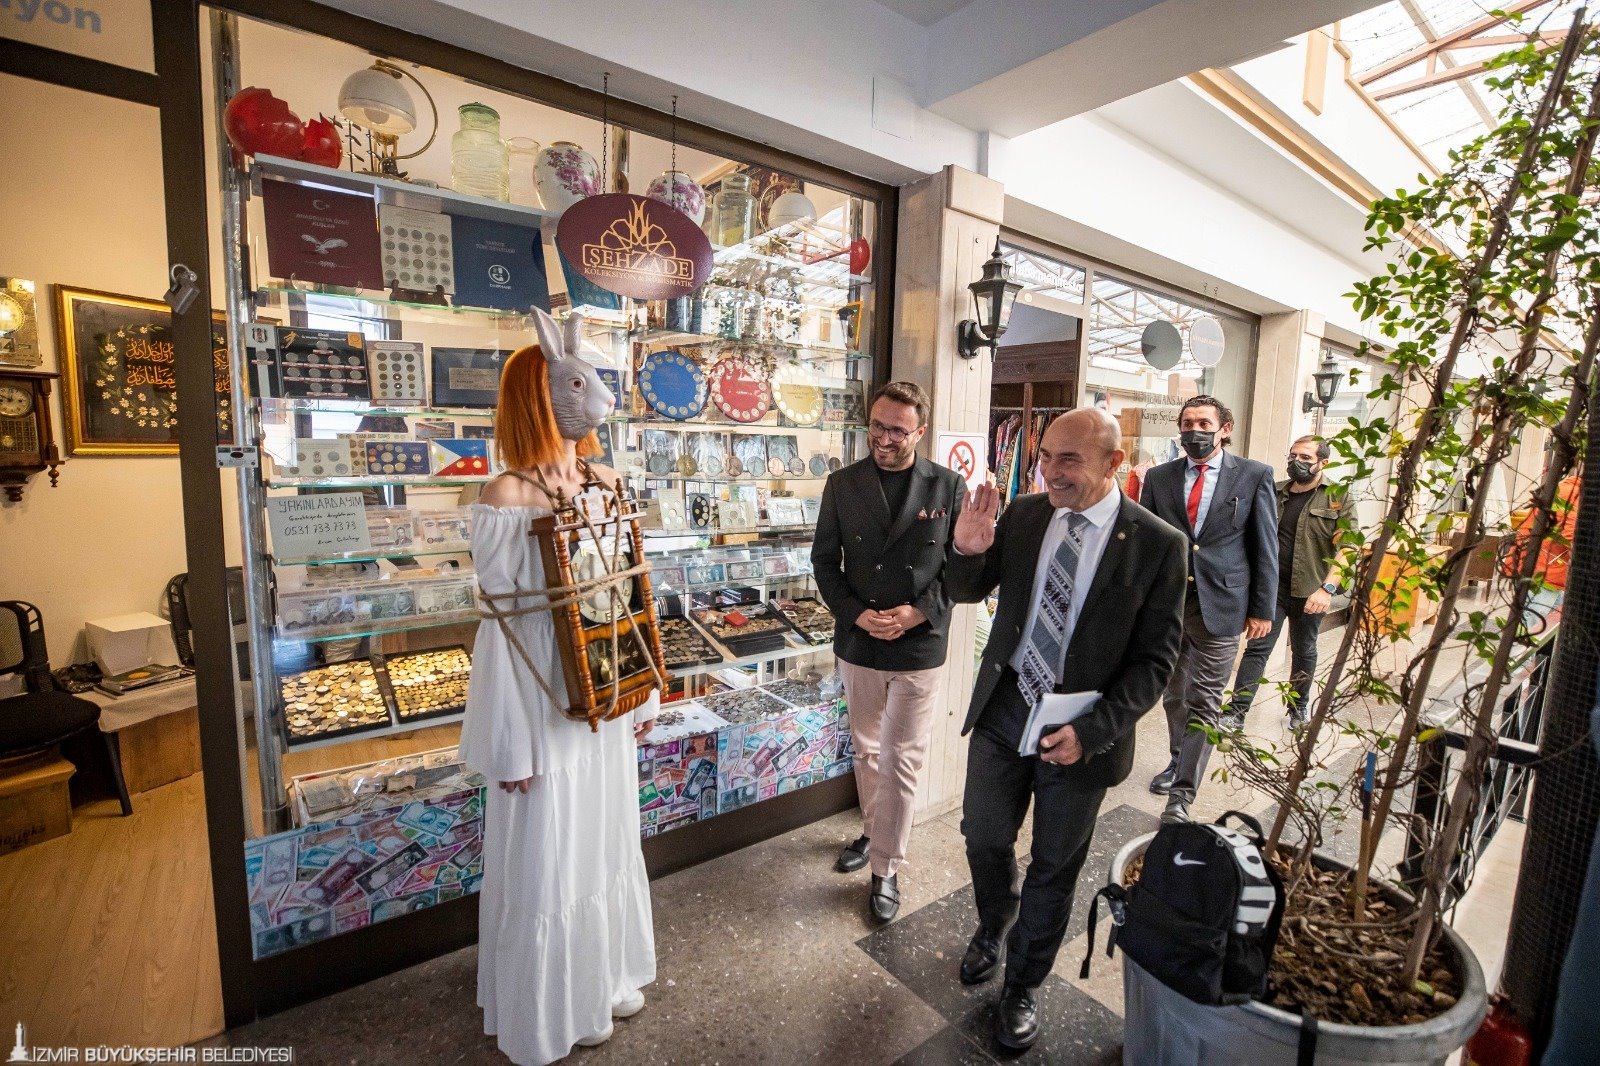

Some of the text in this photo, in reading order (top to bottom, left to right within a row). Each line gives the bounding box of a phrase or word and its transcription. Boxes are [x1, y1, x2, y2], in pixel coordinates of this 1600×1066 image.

[0, 0, 101, 33] yon
[589, 248, 690, 277] ŞEHZADE
[284, 525, 310, 536] 0531
[312, 522, 331, 534] 733
